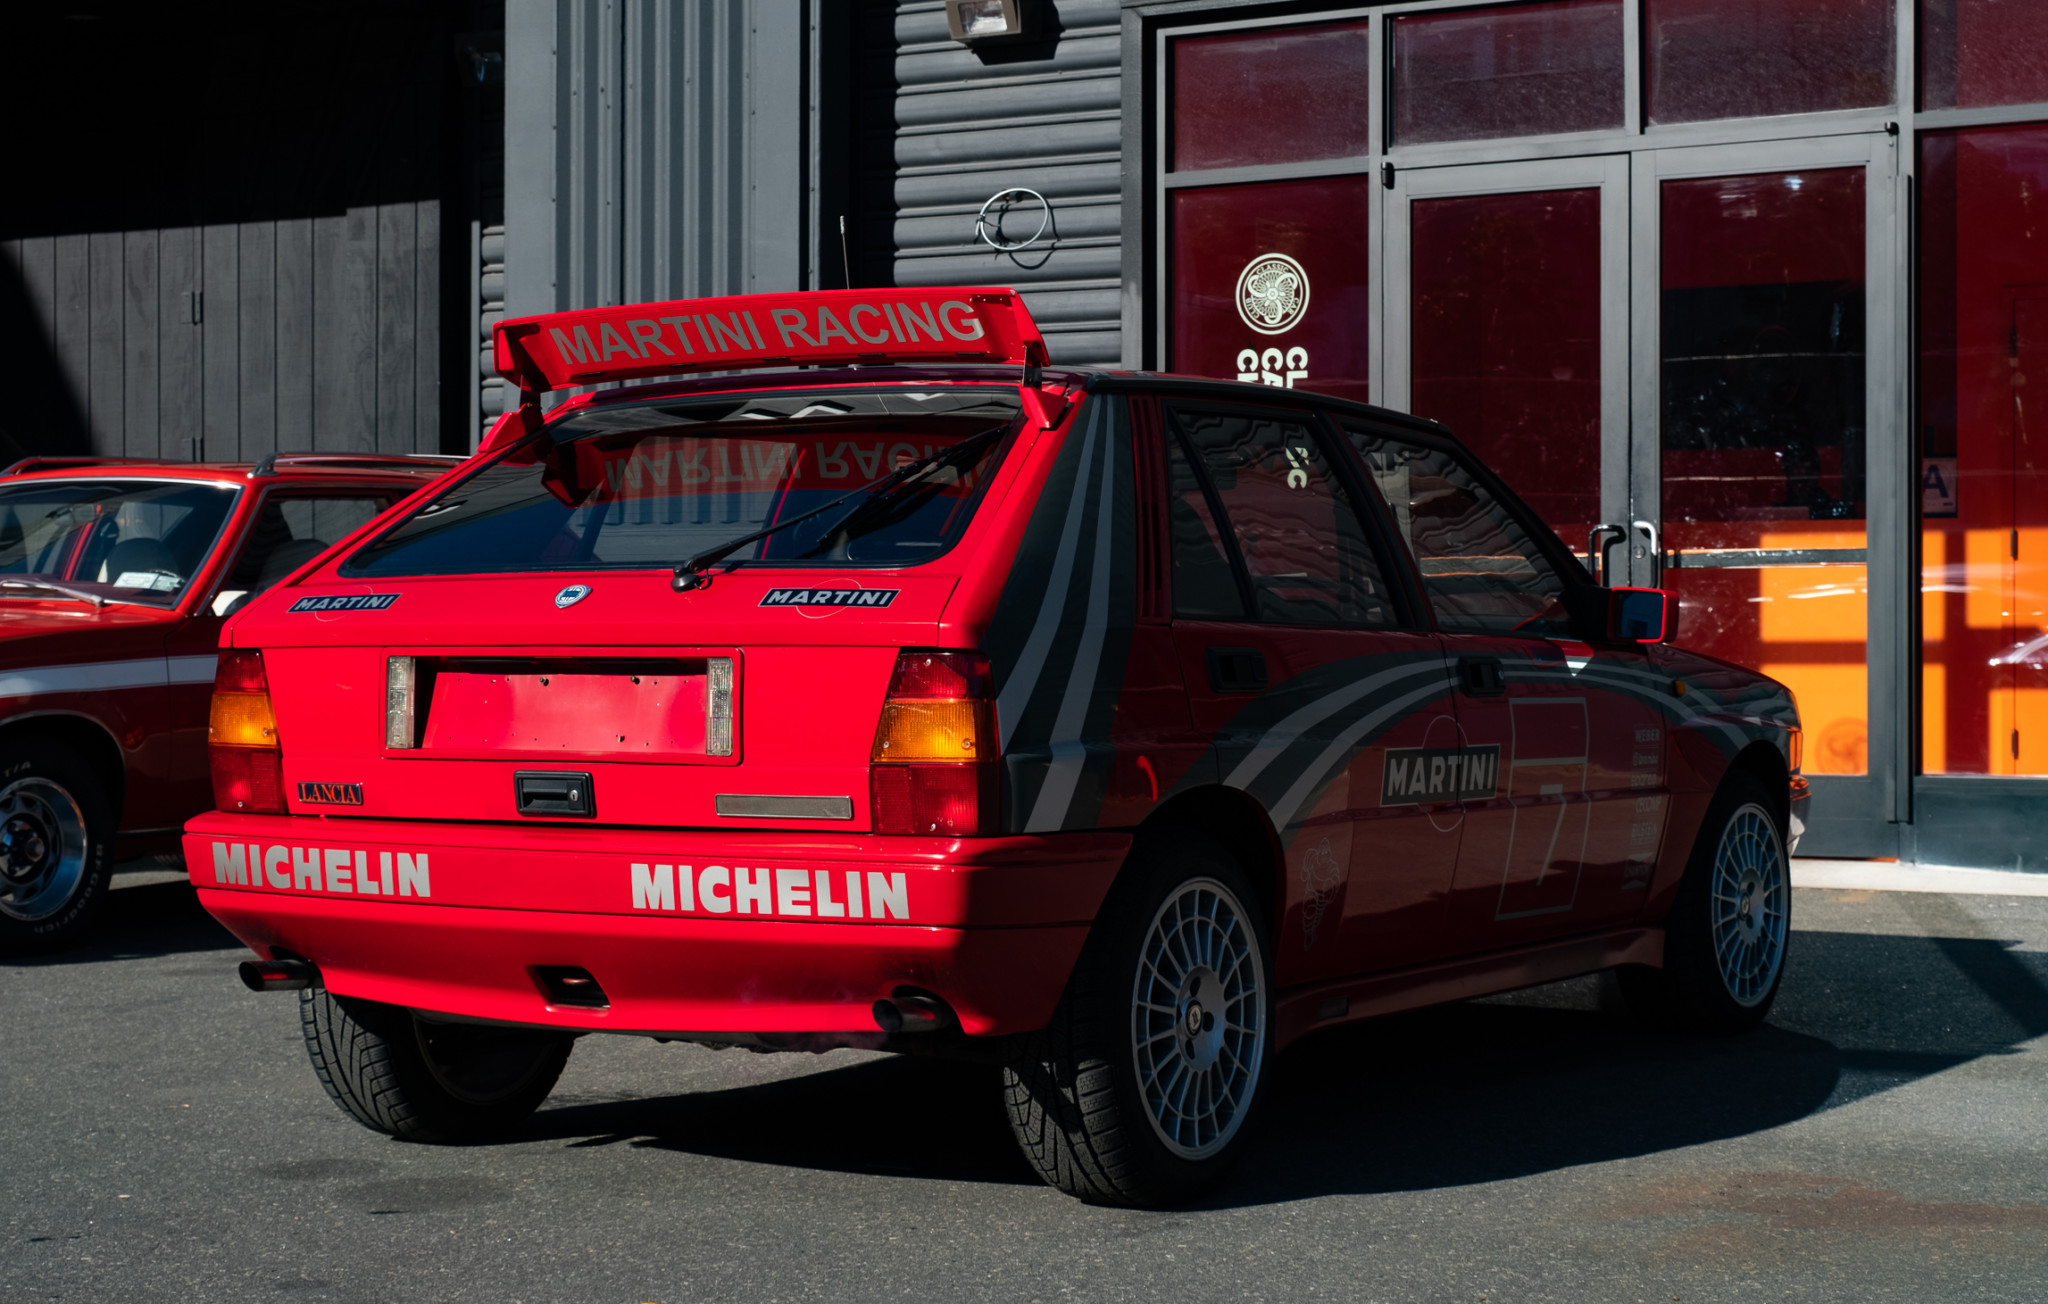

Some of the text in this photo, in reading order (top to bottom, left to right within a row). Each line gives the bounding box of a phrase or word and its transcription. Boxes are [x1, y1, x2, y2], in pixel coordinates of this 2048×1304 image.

[1256, 263, 1289, 276] CLASSIC
[549, 300, 984, 366] MARTINI RACING
[1923, 464, 1949, 498] A
[295, 594, 397, 611] MARTINI
[766, 589, 891, 607] MARTINI
[301, 783, 357, 803] LANCIA
[1387, 752, 1495, 797] MARTINI
[1536, 784, 1567, 886] 7
[212, 841, 431, 898] MICHELIN
[630, 862, 910, 920] MICHELIN
